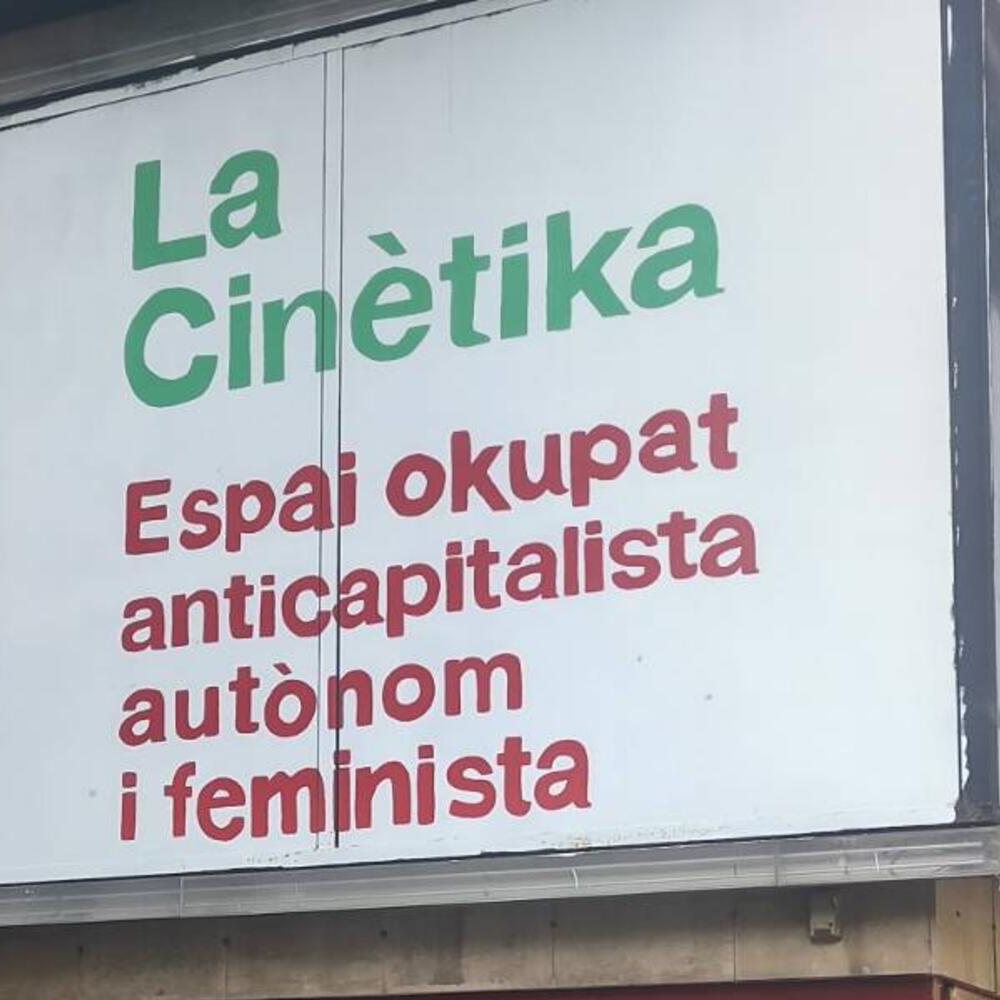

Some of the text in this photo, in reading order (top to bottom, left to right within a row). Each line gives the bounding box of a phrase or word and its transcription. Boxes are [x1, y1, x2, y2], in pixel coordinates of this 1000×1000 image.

[132, 149, 282, 271] La
[124, 202, 725, 408] Cinètika
[125, 392, 739, 555] Espai okupat
[120, 510, 760, 653] anticapitalista
[118, 652, 524, 746] autònom
[119, 735, 592, 842] i feminista
